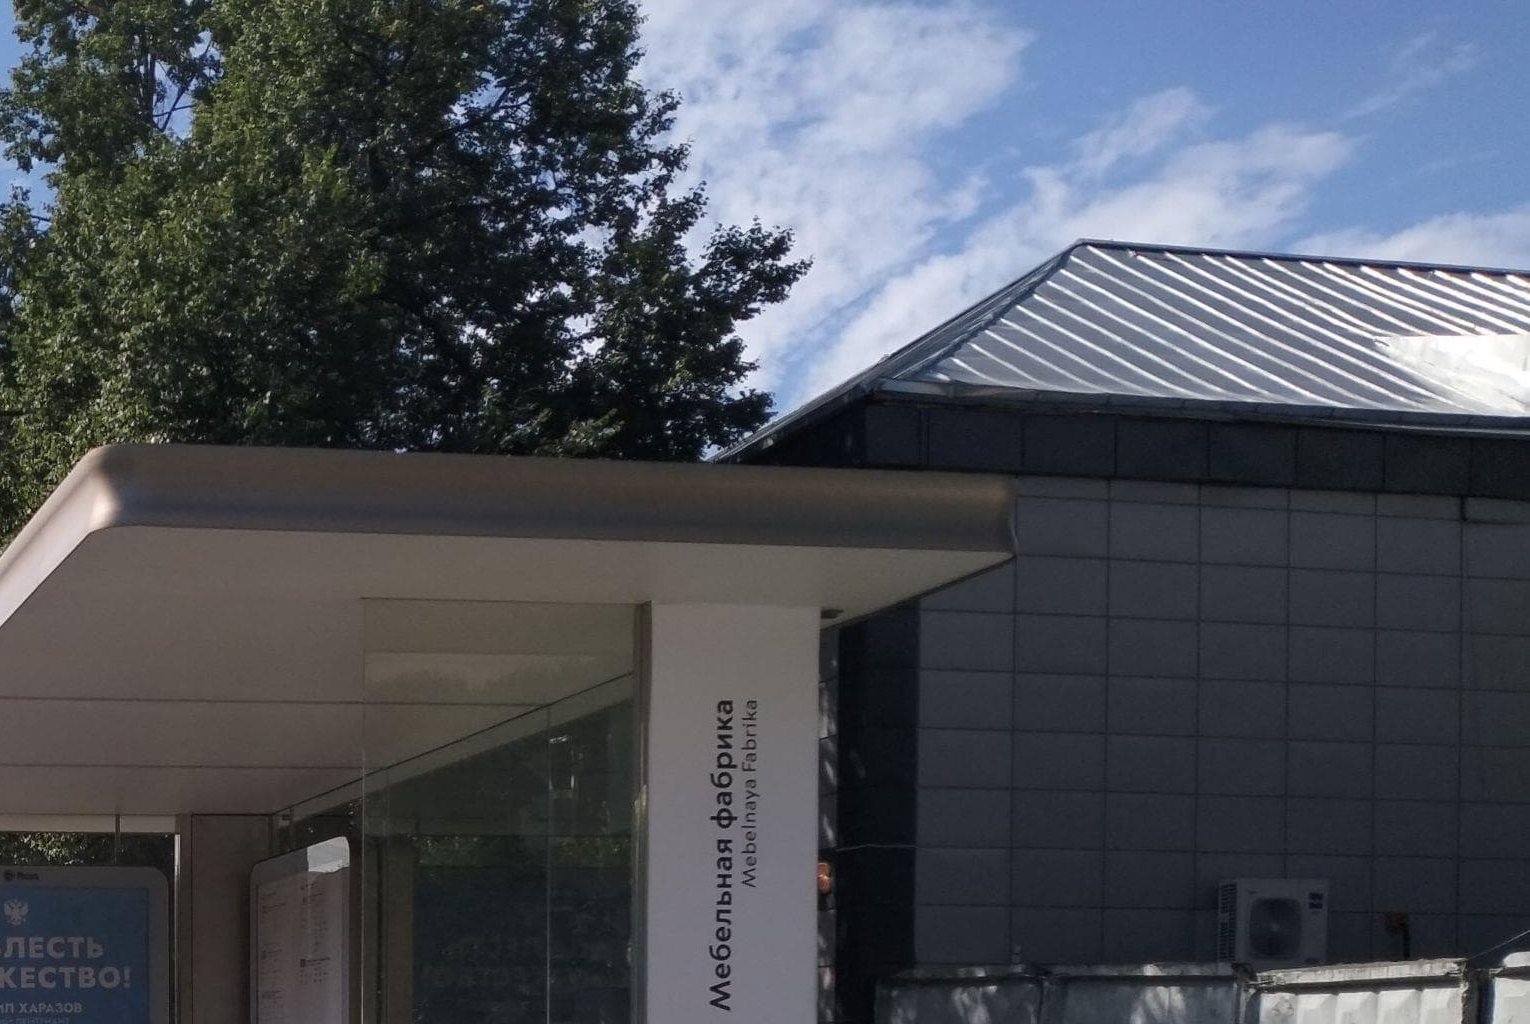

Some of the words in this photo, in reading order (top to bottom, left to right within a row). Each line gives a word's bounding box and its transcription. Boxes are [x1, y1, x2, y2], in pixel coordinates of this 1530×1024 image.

[710, 699, 738, 829] фабрика
[741, 699, 758, 772] Fabrika
[741, 778, 760, 888] Mebelnaya
[709, 839, 733, 1012] Мебельная
[18, 1002, 84, 1014] ХАРАЗОВ
